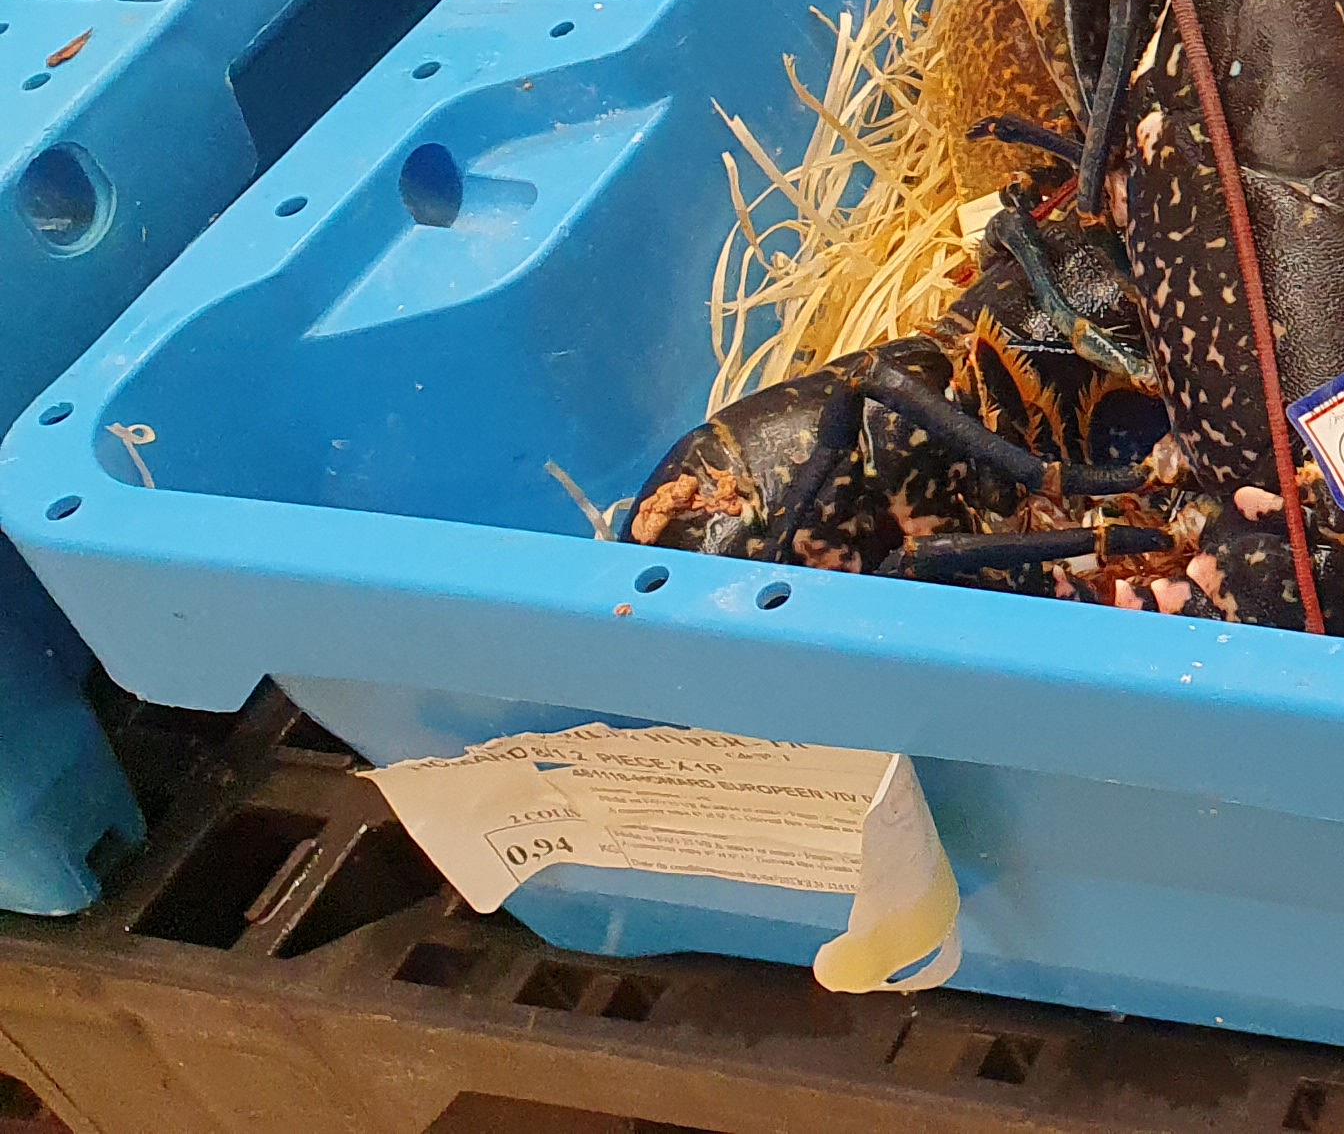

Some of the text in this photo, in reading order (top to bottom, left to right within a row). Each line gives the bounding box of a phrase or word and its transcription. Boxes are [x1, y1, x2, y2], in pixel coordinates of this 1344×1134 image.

[596, 752, 671, 771] PIECE
[717, 780, 825, 800] EUROPEEN
[509, 815, 521, 824] 2
[506, 836, 574, 866] 0,94
